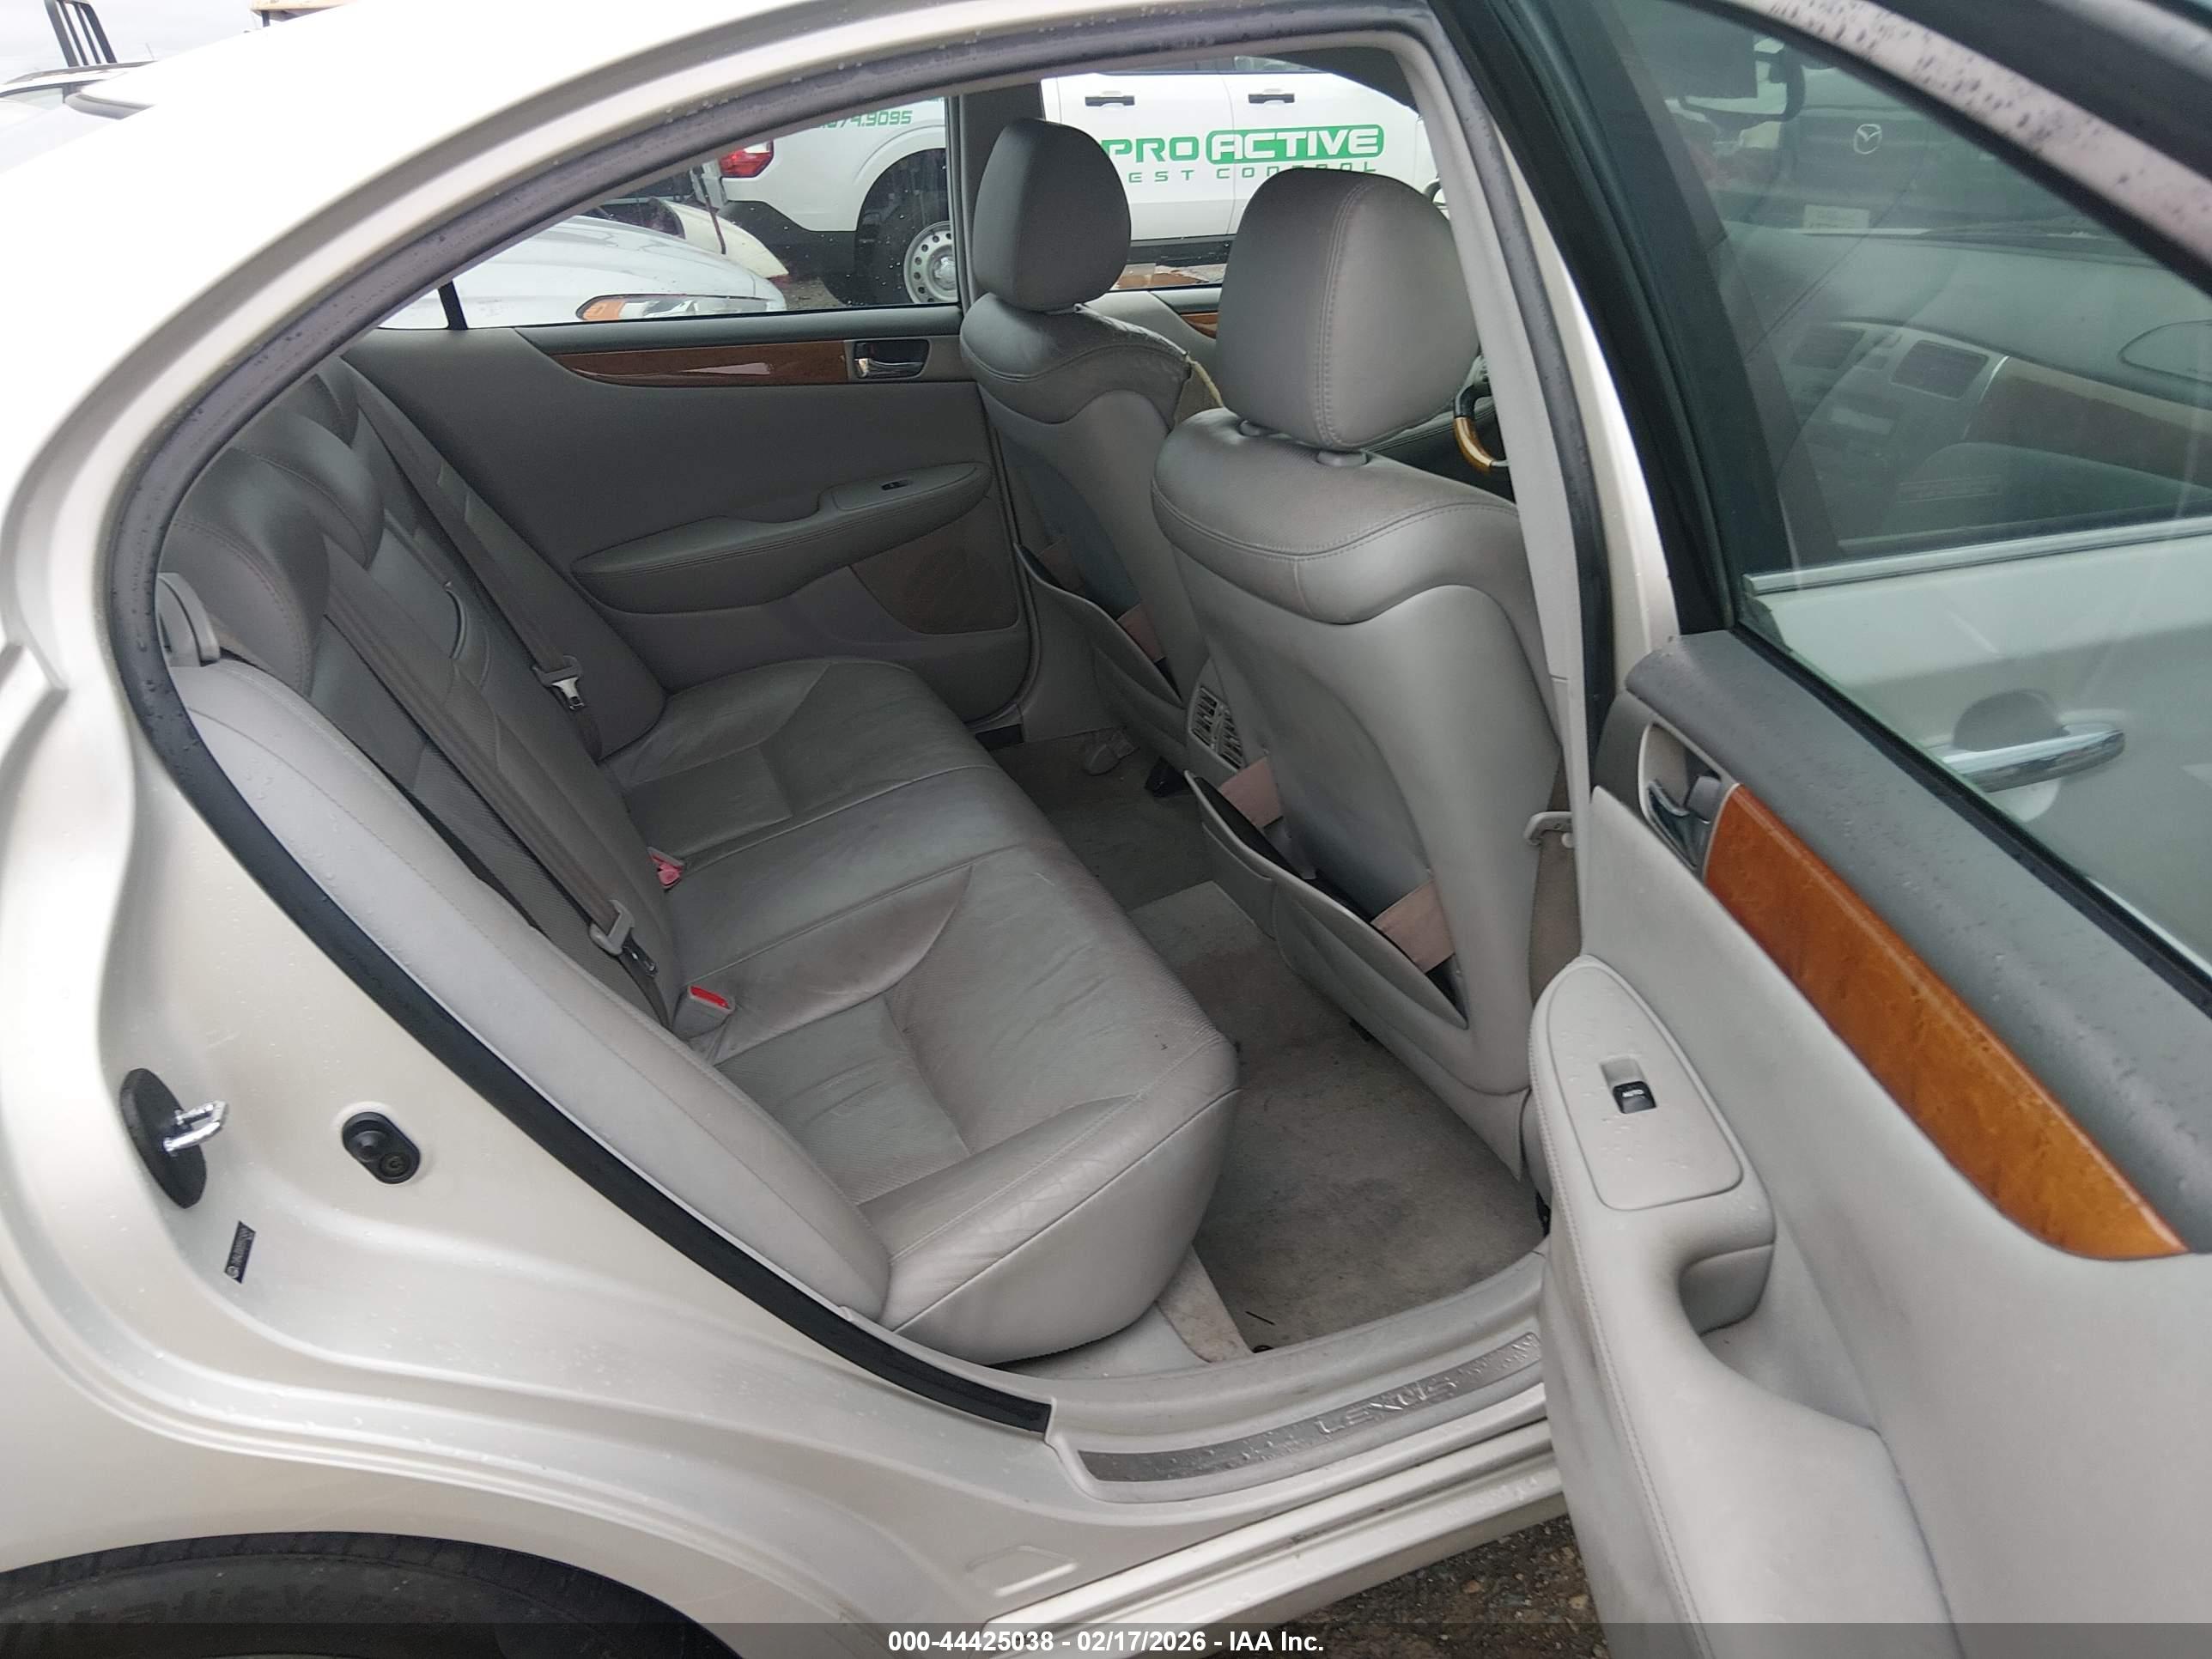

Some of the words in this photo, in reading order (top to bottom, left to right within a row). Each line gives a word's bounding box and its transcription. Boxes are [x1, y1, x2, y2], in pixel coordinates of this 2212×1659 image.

[1101, 136, 1200, 163] PRO
[1211, 128, 1380, 161] ACTIVE
[1128, 169, 1194, 183] EST
[1316, 1376, 1457, 1435] LEXUS
